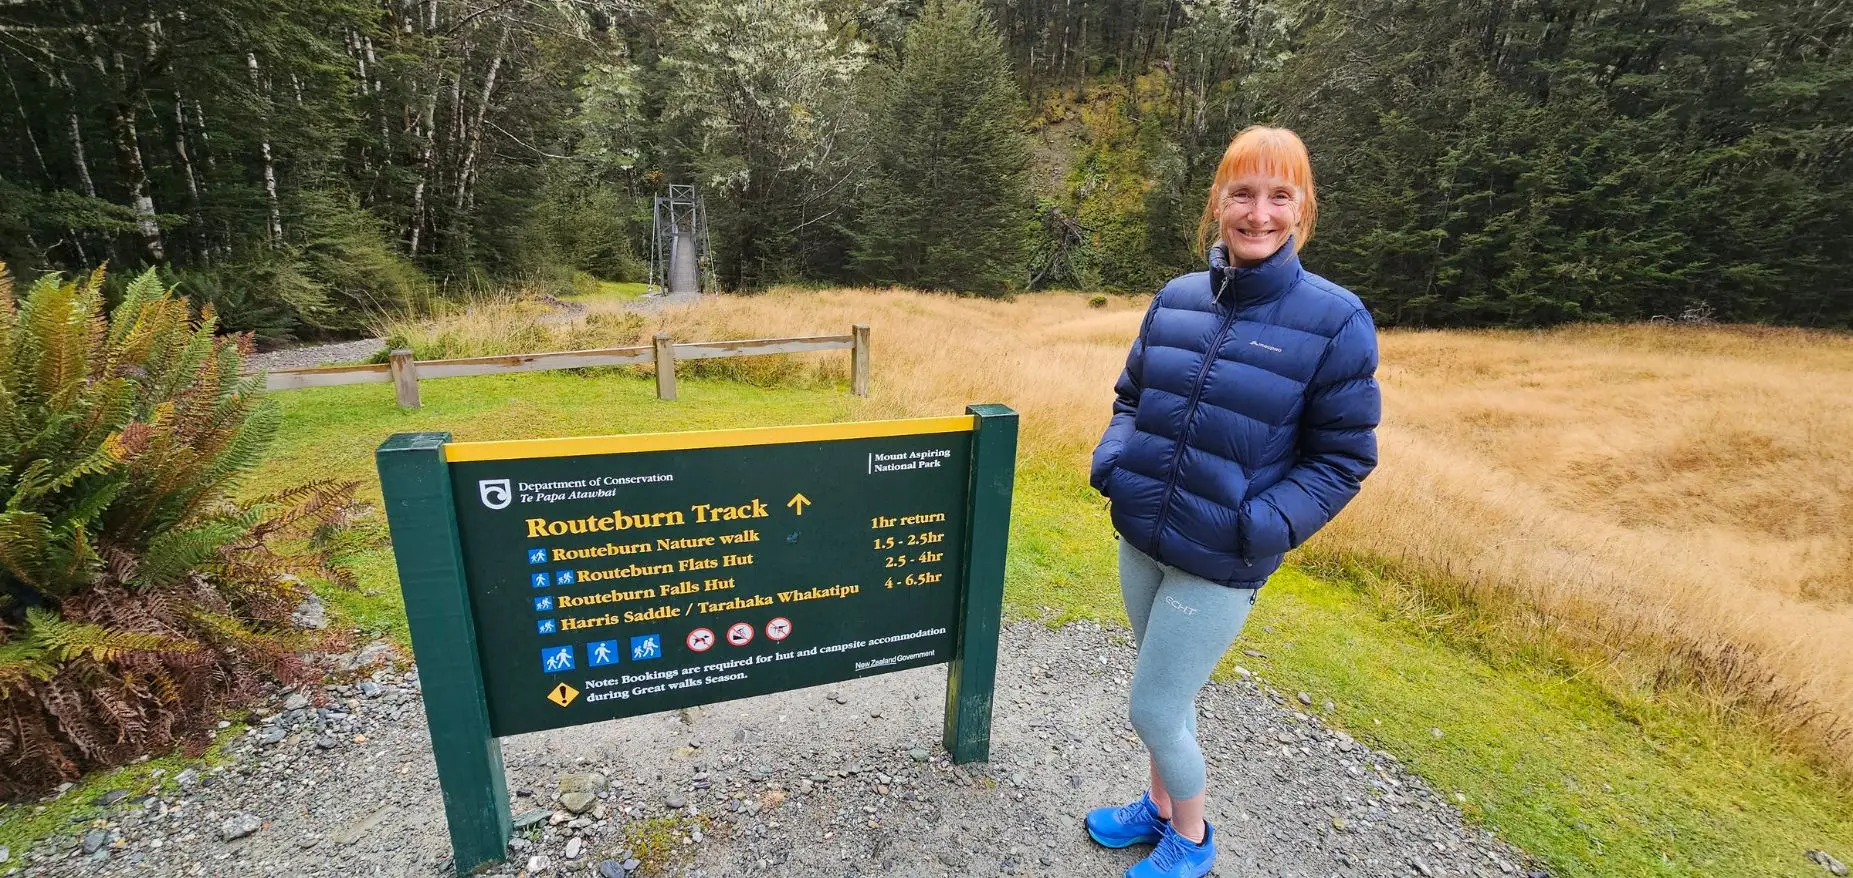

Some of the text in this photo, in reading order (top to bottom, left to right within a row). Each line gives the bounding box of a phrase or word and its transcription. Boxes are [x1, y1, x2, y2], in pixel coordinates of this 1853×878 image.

[874, 459, 941, 472] National Park
[875, 449, 951, 462] Mount Aspiring
[518, 473, 673, 493] Department of Conservation
[520, 488, 616, 503] Te Papa Atawhai
[525, 498, 769, 538] Routeburn Track
[871, 512, 945, 529] 1hr return
[552, 529, 760, 561] Routeburn Nature walk
[873, 537, 895, 550] 1.5
[907, 531, 944, 545] 2.5hr
[576, 553, 754, 583] Routeburn Flats Hut
[885, 555, 906, 568] 2.5
[918, 551, 943, 563] 4hr
[884, 577, 893, 589] 4
[905, 571, 942, 587] 6.5hr
[558, 577, 736, 609] Routeburn Falls Hut
[560, 613, 620, 631] Harris
[624, 606, 681, 624] Saddle
[697, 594, 774, 614] Tarahaka
[777, 584, 860, 603] Whakatipu
[585, 626, 946, 690] Note: Bookings are required for hut and campsite accommodation
[855, 650, 935, 670] New Zealand Government
[586, 671, 748, 703] during Great walks Season.
